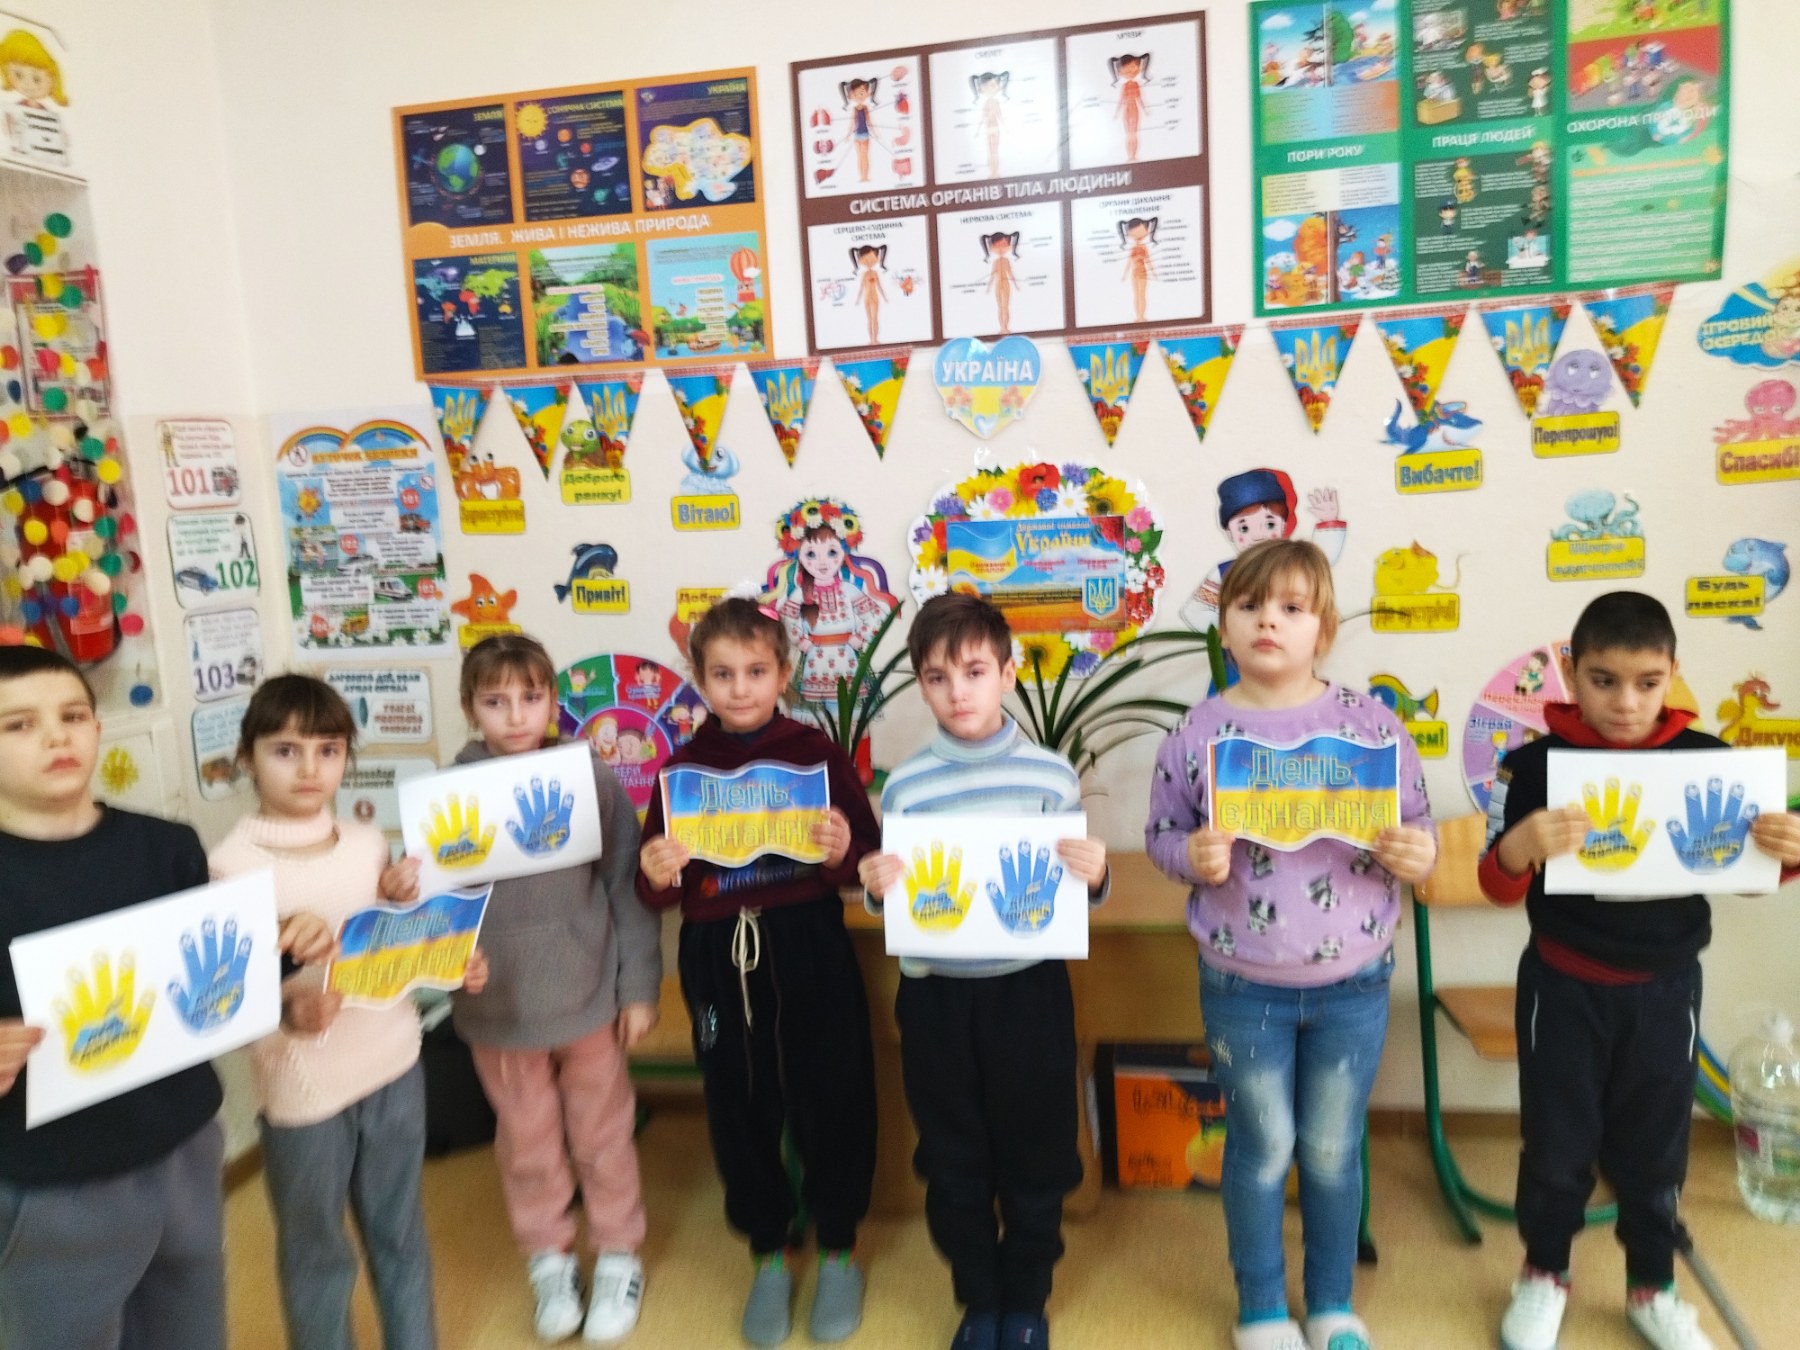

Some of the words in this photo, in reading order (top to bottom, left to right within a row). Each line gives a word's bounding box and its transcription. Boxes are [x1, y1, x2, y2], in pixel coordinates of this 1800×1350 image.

[1432, 131, 1478, 150] ПРАЦЯ
[1480, 124, 1532, 145] ЛЮДЕЙ
[1566, 115, 1638, 134] ОХОРОНА
[1287, 148, 1323, 164] ПОРИ
[1325, 144, 1362, 160] РОКУ
[849, 192, 928, 216] СИСТЕМА
[931, 184, 1000, 207] ОРГАНІВ
[1004, 178, 1043, 200] ТІЛА
[1047, 170, 1132, 196] ЛЮДИНИ
[511, 227, 555, 244] ЖИВА
[567, 221, 631, 239] НЕЖИВА
[635, 214, 711, 234] ПРИРОДА
[941, 356, 1034, 383] УКРАЇНА
[1533, 420, 1618, 446] Перепрошую!
[168, 465, 210, 497] 101
[564, 471, 626, 486] Доброго
[1399, 459, 1481, 487] Вибачте!
[574, 488, 622, 503] ранку!
[678, 502, 736, 525] Вітаю!
[1016, 530, 1091, 557] України
[216, 559, 258, 591] 102
[575, 585, 627, 607] Привіт!
[194, 662, 235, 695] 103
[1247, 748, 1352, 793] День
[699, 775, 790, 816] День
[1220, 799, 1391, 836] єднання
[366, 909, 450, 953] День
